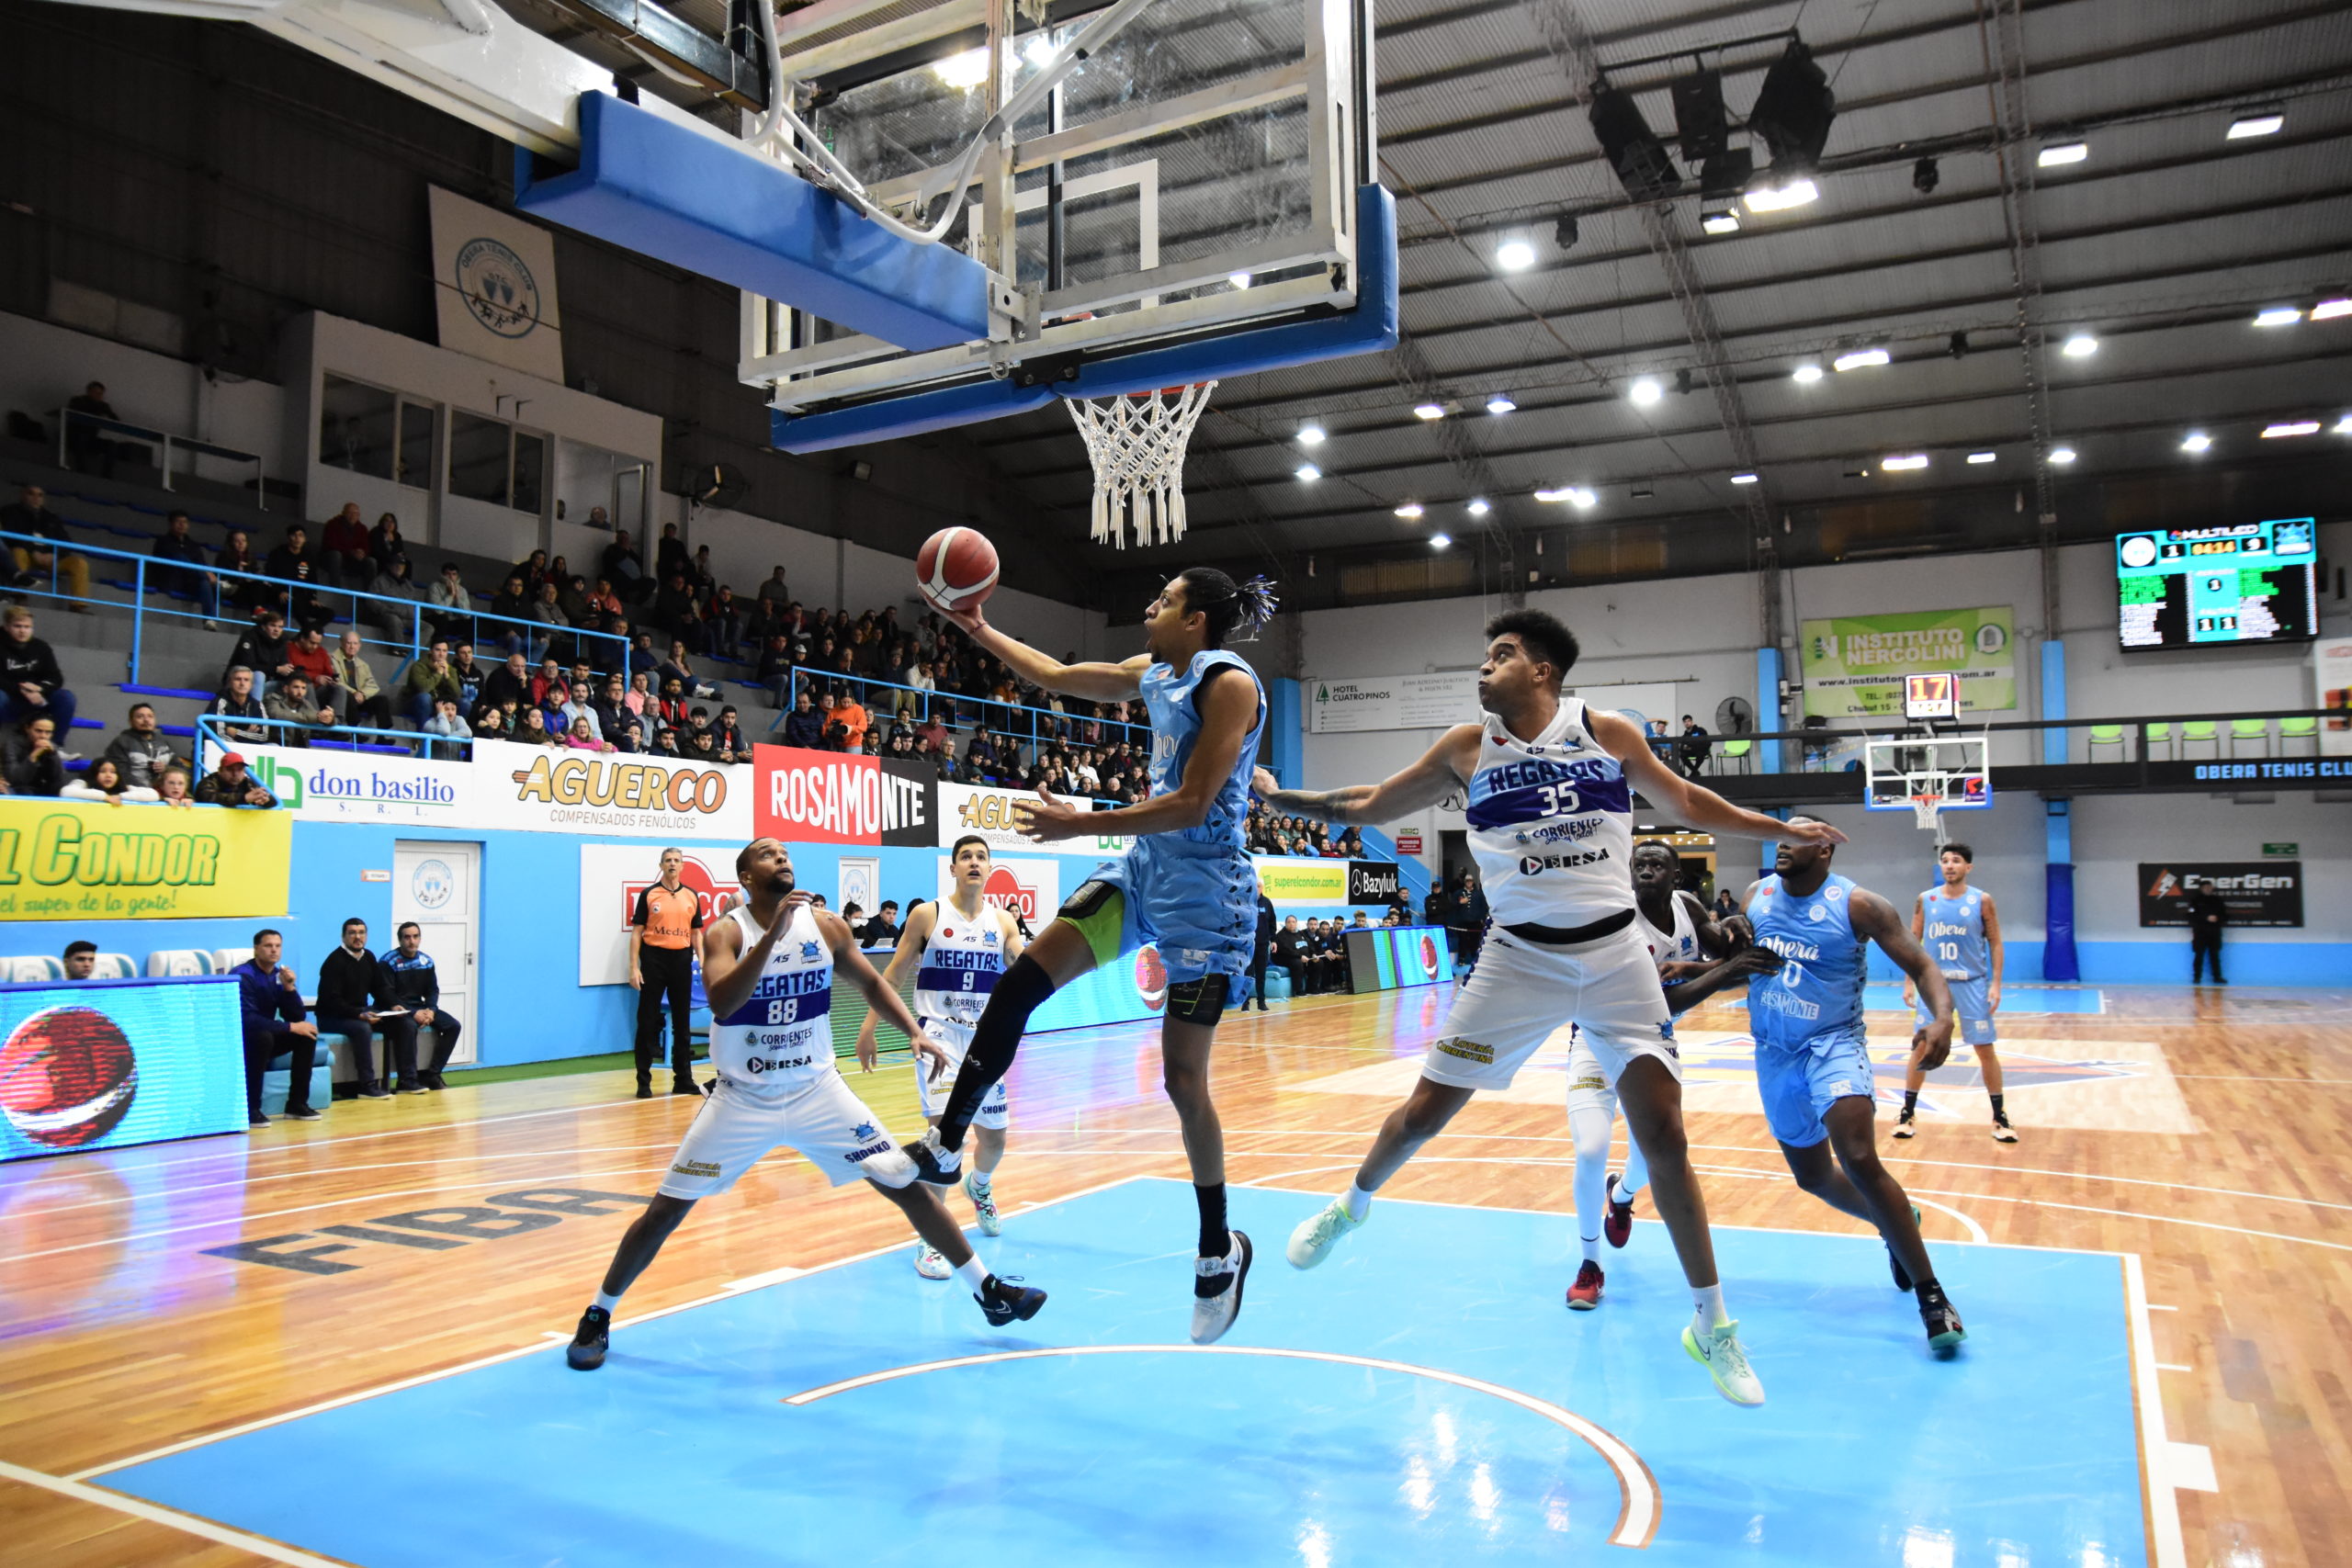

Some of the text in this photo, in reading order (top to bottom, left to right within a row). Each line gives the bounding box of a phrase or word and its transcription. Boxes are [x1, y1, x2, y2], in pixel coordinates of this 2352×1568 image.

[1847, 628, 1962, 649] INSTITUTO
[1847, 645, 1964, 665] NERCOLINI
[1333, 685, 1358, 694] HOTEL
[1818, 670, 1996, 687] www.institutoncom.ar
[1910, 677, 1948, 701] 17
[2195, 763, 2257, 780] OBERA
[2260, 762, 2315, 778] TENIS
[310, 769, 454, 803] don basilio
[516, 755, 727, 814] AGUERCO
[771, 763, 925, 836] ROSAMONTE
[1537, 781, 1580, 817] 35
[550, 808, 696, 829] COMPENSADOS FENÓLICOS
[0, 829, 21, 886] L
[1544, 848, 1610, 869] ERSA
[1274, 875, 1341, 889] superelcondor.com.ar
[1363, 872, 1397, 898] Bazyluk
[24, 897, 72, 915] super
[78, 892, 99, 911] de
[106, 891, 123, 911] la
[129, 889, 177, 916] gente!
[773, 953, 790, 964] AS
[935, 950, 1000, 971] REGATAS
[1939, 942, 1958, 961] 10
[962, 972, 975, 991] 9
[1782, 960, 1803, 987] 0
[767, 998, 797, 1024] 88
[1760, 991, 1818, 1019] ROSAMONTE
[761, 1027, 812, 1045] CORRIENTES
[1437, 1040, 1493, 1065] CORRENTINA
[844, 1141, 891, 1163] SHONKO
[197, 1188, 651, 1276] FIBA
